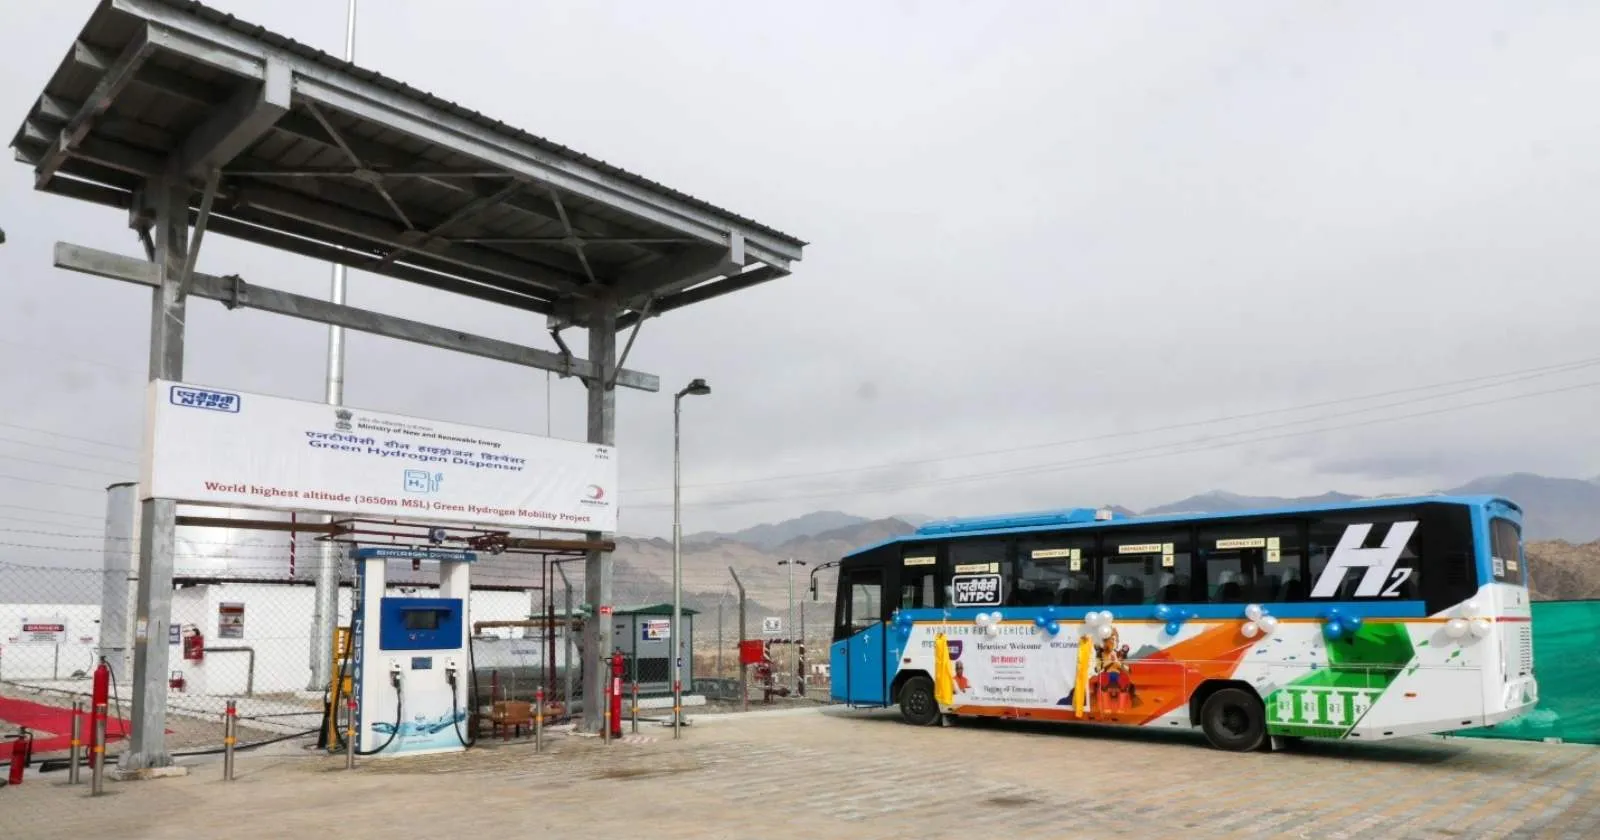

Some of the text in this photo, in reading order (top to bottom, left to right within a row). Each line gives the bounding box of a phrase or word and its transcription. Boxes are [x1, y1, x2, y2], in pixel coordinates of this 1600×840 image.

[181, 398, 230, 409] NTPC
[357, 423, 391, 433] Ministry
[438, 434, 477, 444] Renewable
[478, 439, 502, 448] Energy
[309, 440, 523, 471] Green Hydrogen Dispenser
[204, 481, 591, 524] World highest altitude (3650m MSL) Green Hydrogen Mobility Project
[959, 592, 995, 602] NTPC
[1009, 642, 1042, 650] Welcome
